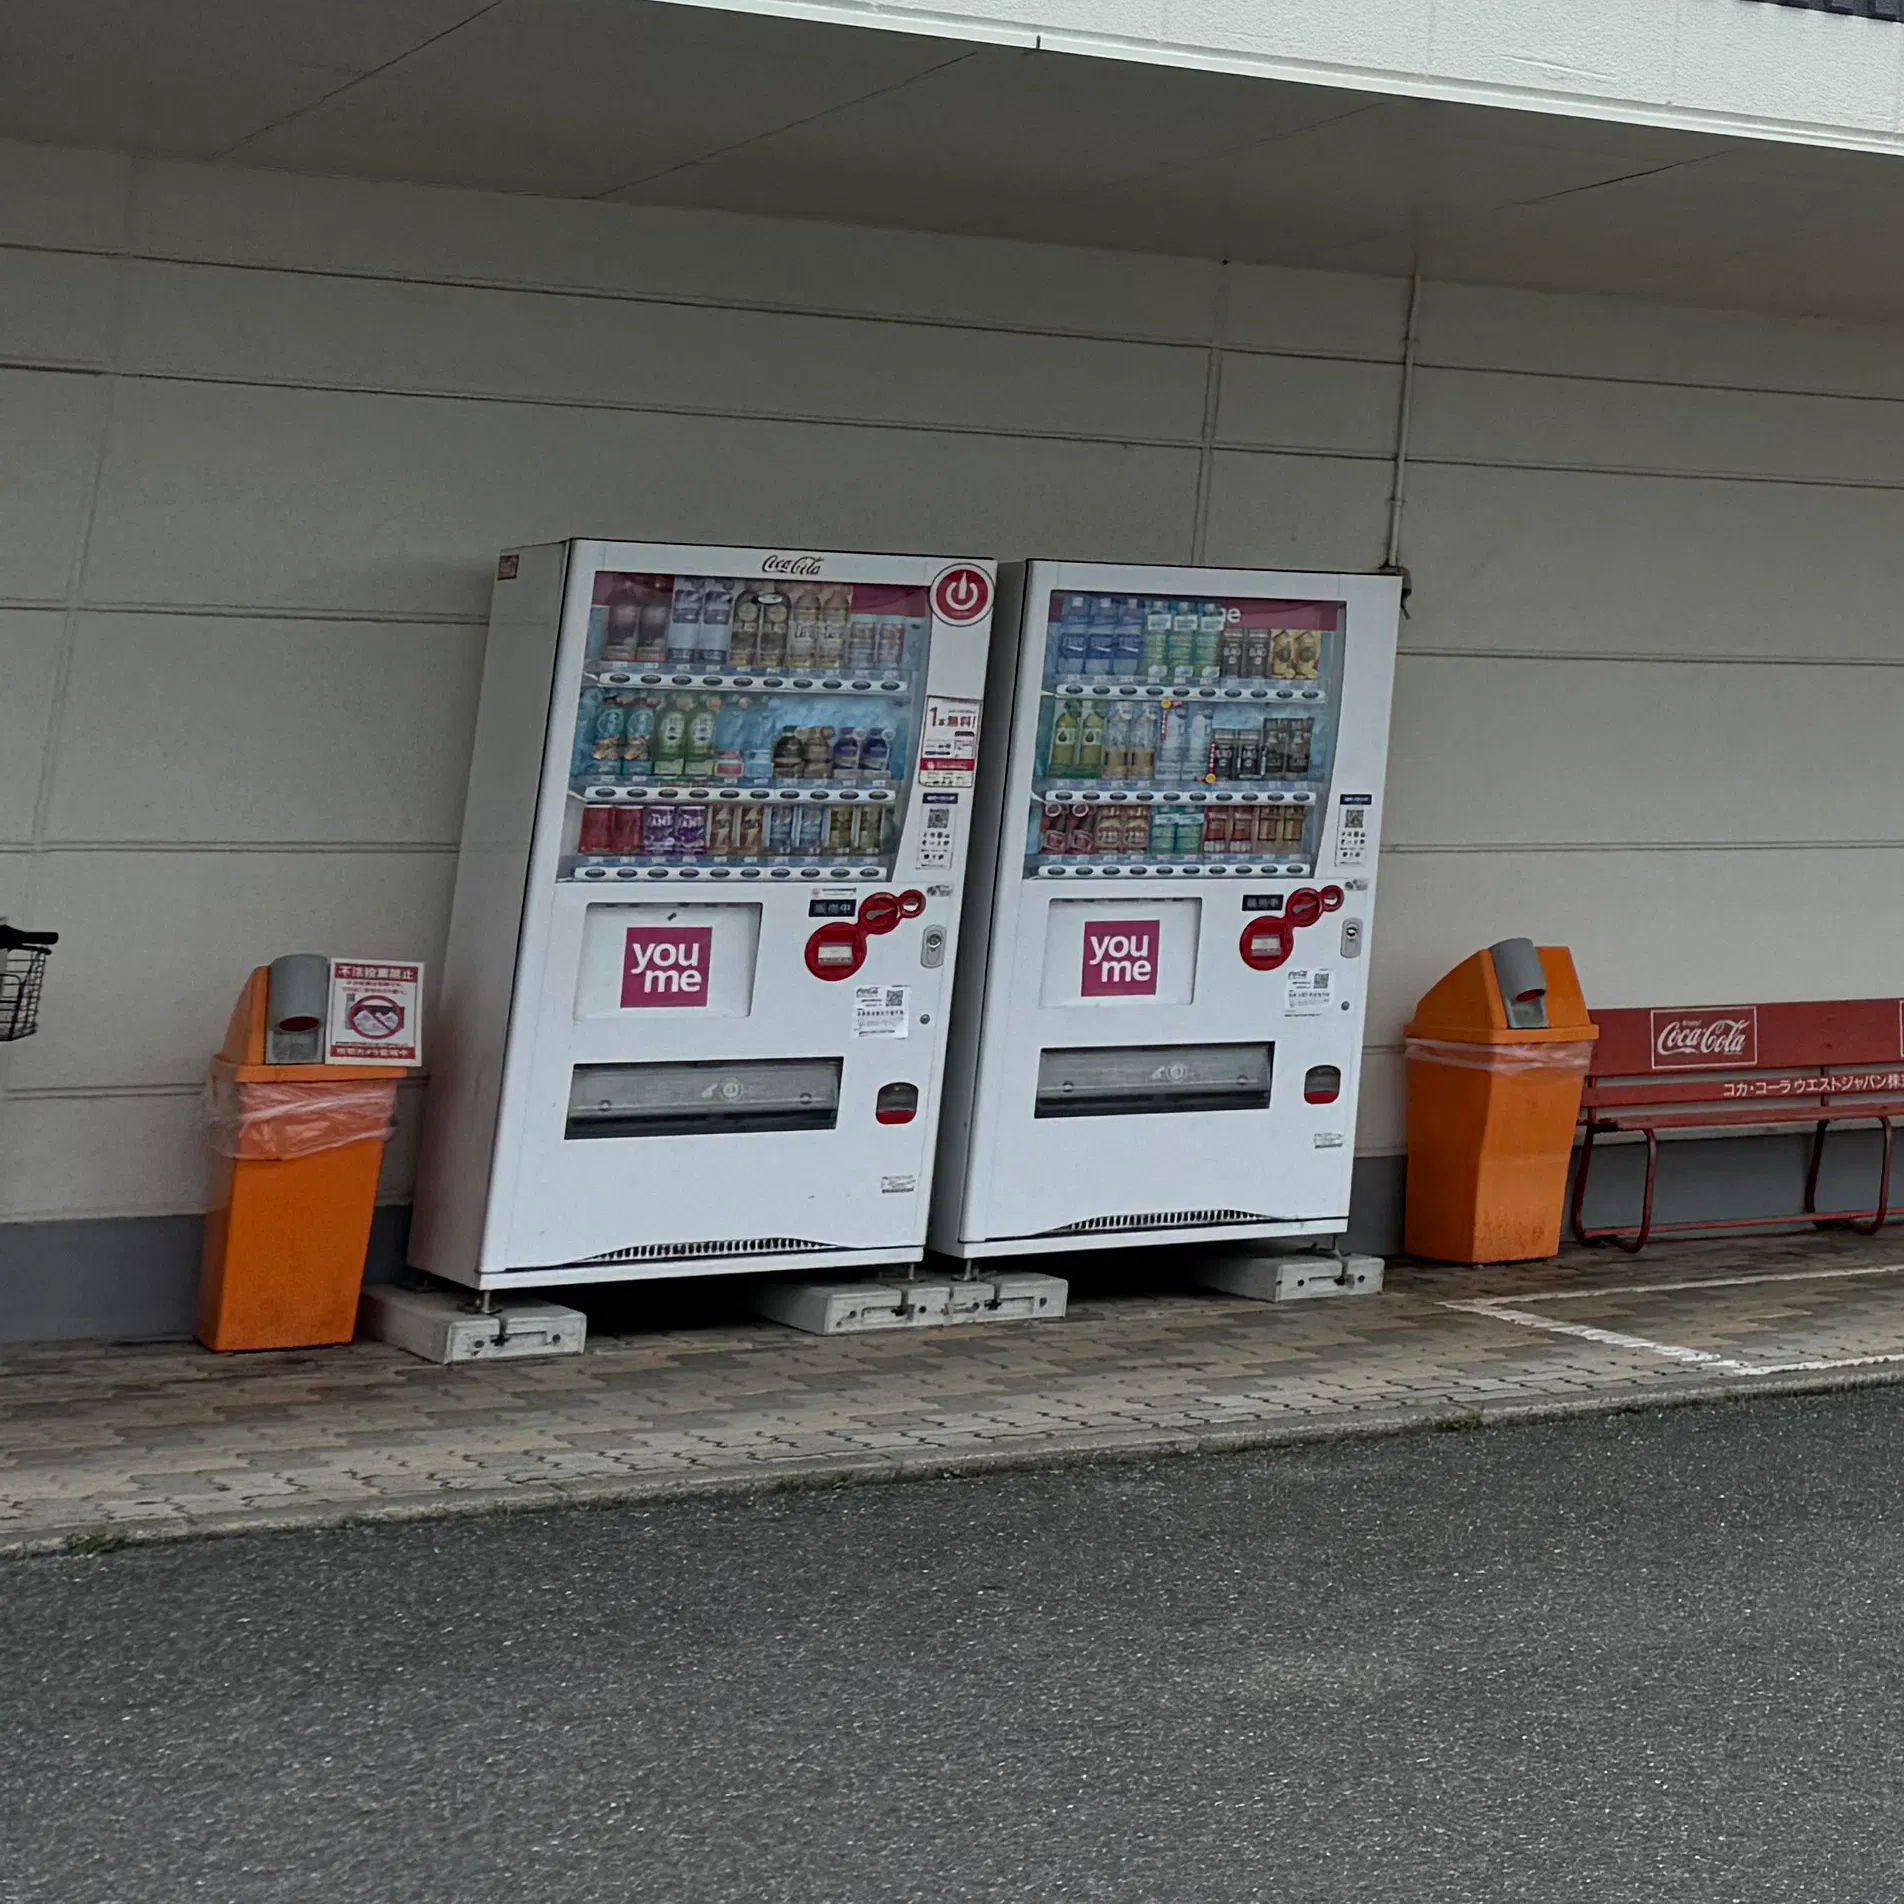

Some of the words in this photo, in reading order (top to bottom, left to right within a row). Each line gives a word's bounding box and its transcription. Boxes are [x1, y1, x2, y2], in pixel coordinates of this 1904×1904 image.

[631, 943, 699, 974] you
[1089, 935, 1149, 965] you
[644, 969, 702, 993] me
[1101, 960, 1152, 983] me
